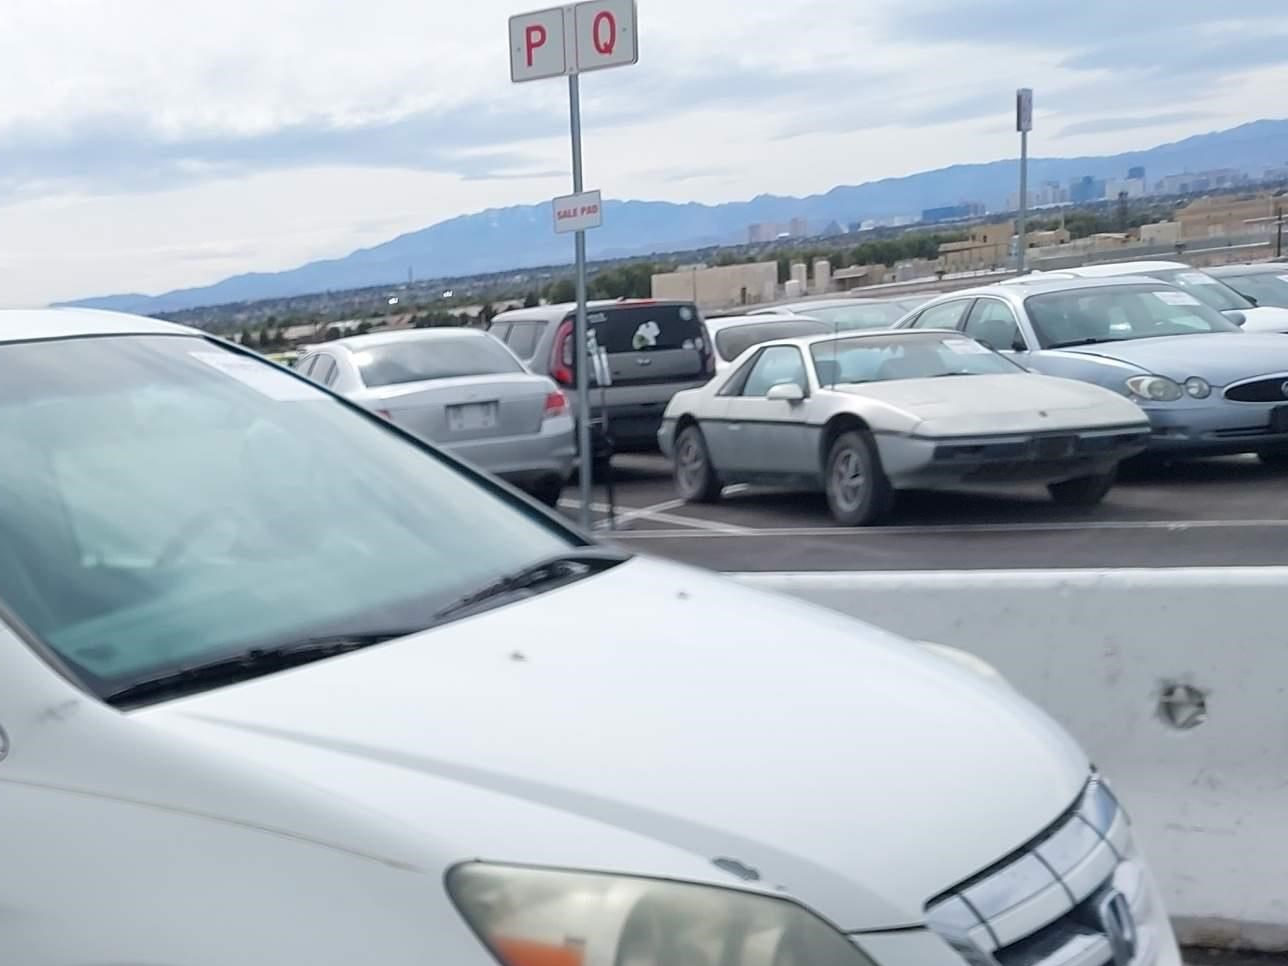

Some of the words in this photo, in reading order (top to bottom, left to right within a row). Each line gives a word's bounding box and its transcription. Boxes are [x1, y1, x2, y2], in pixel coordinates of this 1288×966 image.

[525, 24, 547, 67] P
[593, 10, 617, 55] Q
[557, 207, 578, 220] SALE
